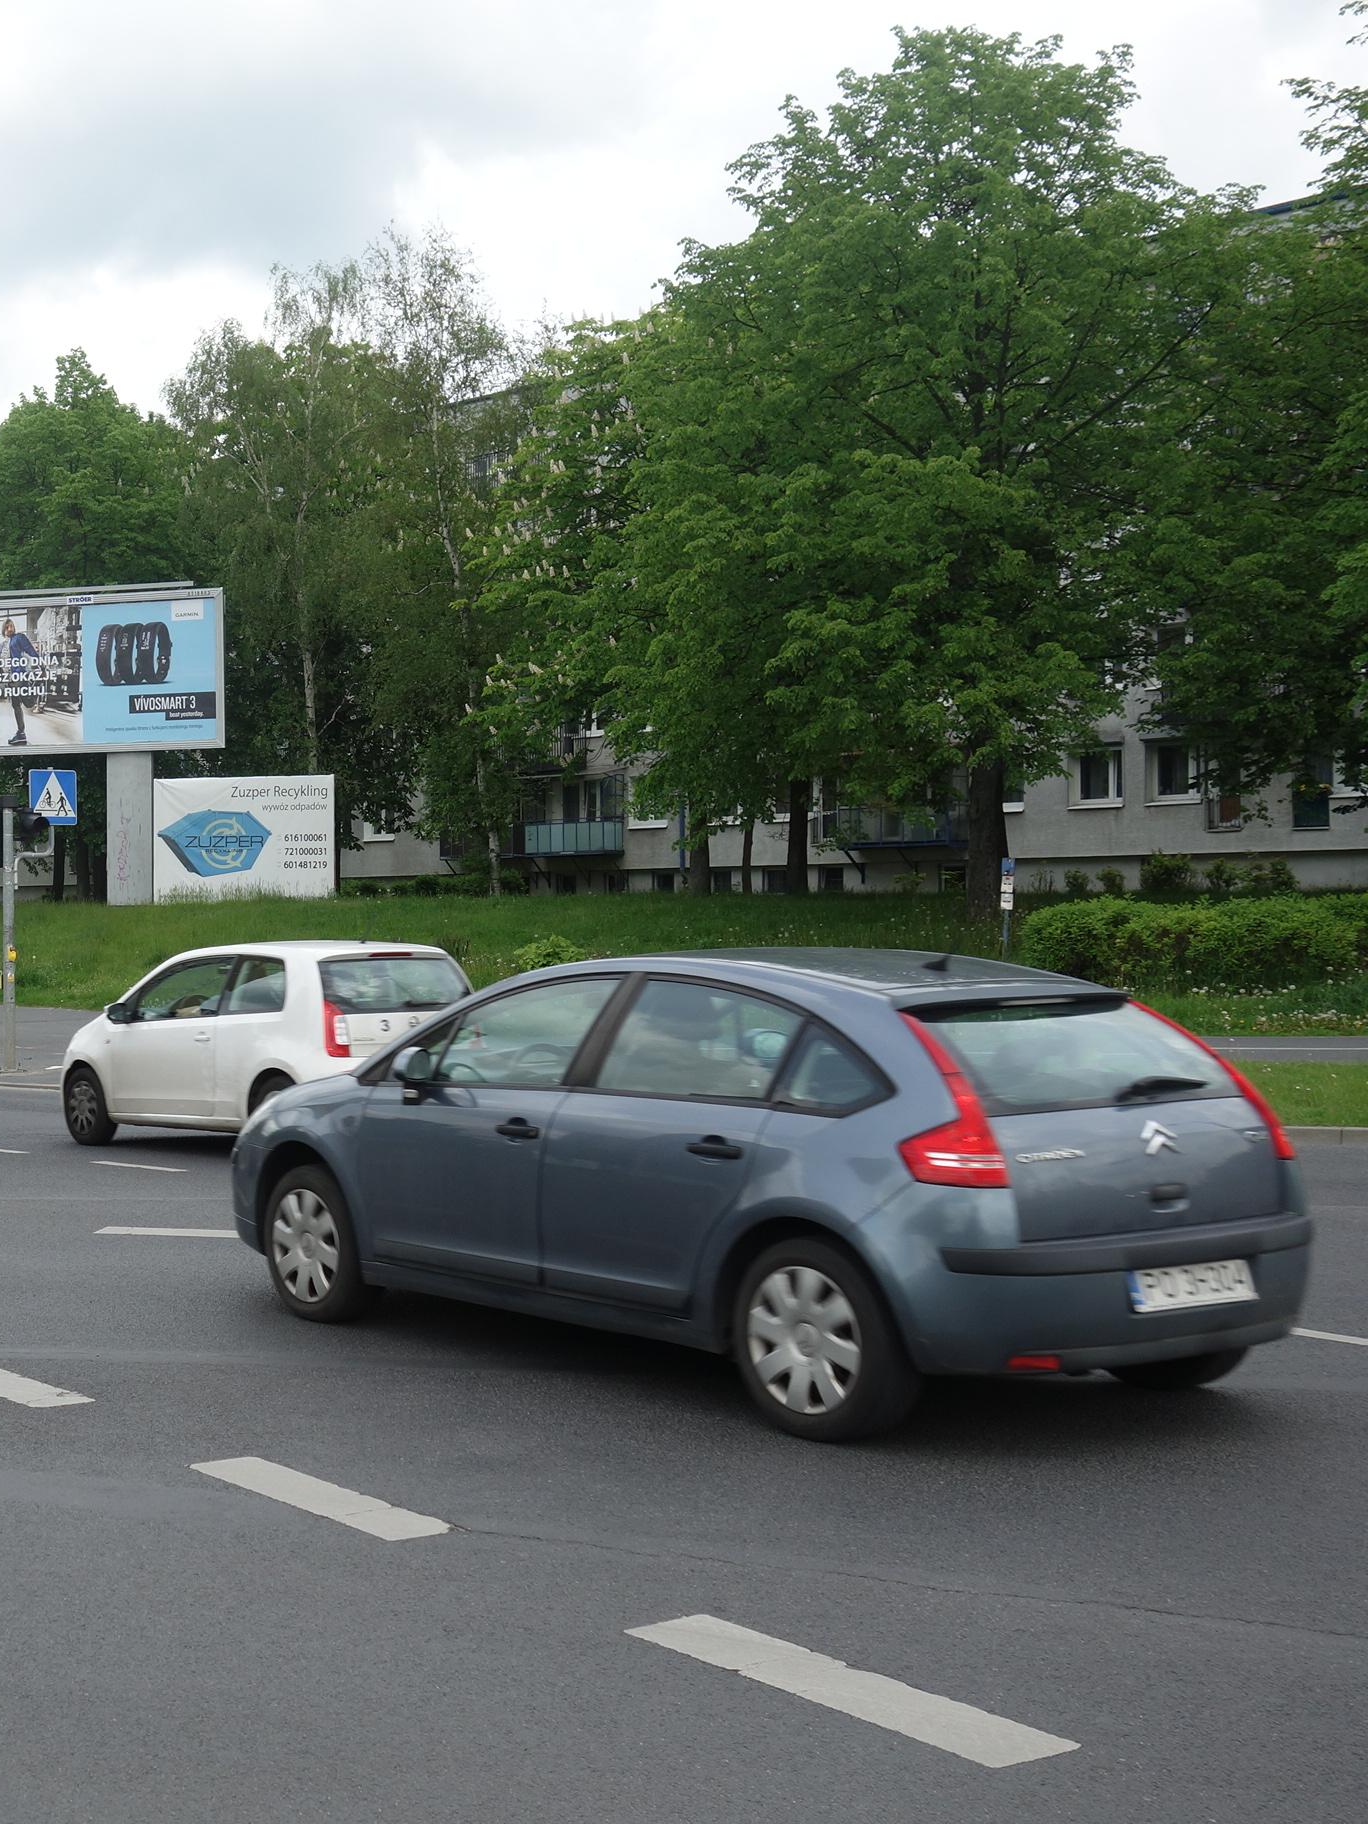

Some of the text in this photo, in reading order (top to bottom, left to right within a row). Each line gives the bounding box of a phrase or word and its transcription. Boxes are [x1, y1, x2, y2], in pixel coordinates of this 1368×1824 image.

[31, 655, 59, 666] DNIA
[4, 685, 45, 697] RUCHU
[189, 695, 196, 709] 3
[231, 784, 328, 800] Zuzper Recykling
[262, 801, 328, 813] wywóz odpadów
[185, 835, 264, 848] ZUZPER
[284, 833, 327, 842] 616100061
[284, 847, 327, 856] 721000031
[283, 860, 328, 869] 601481219
